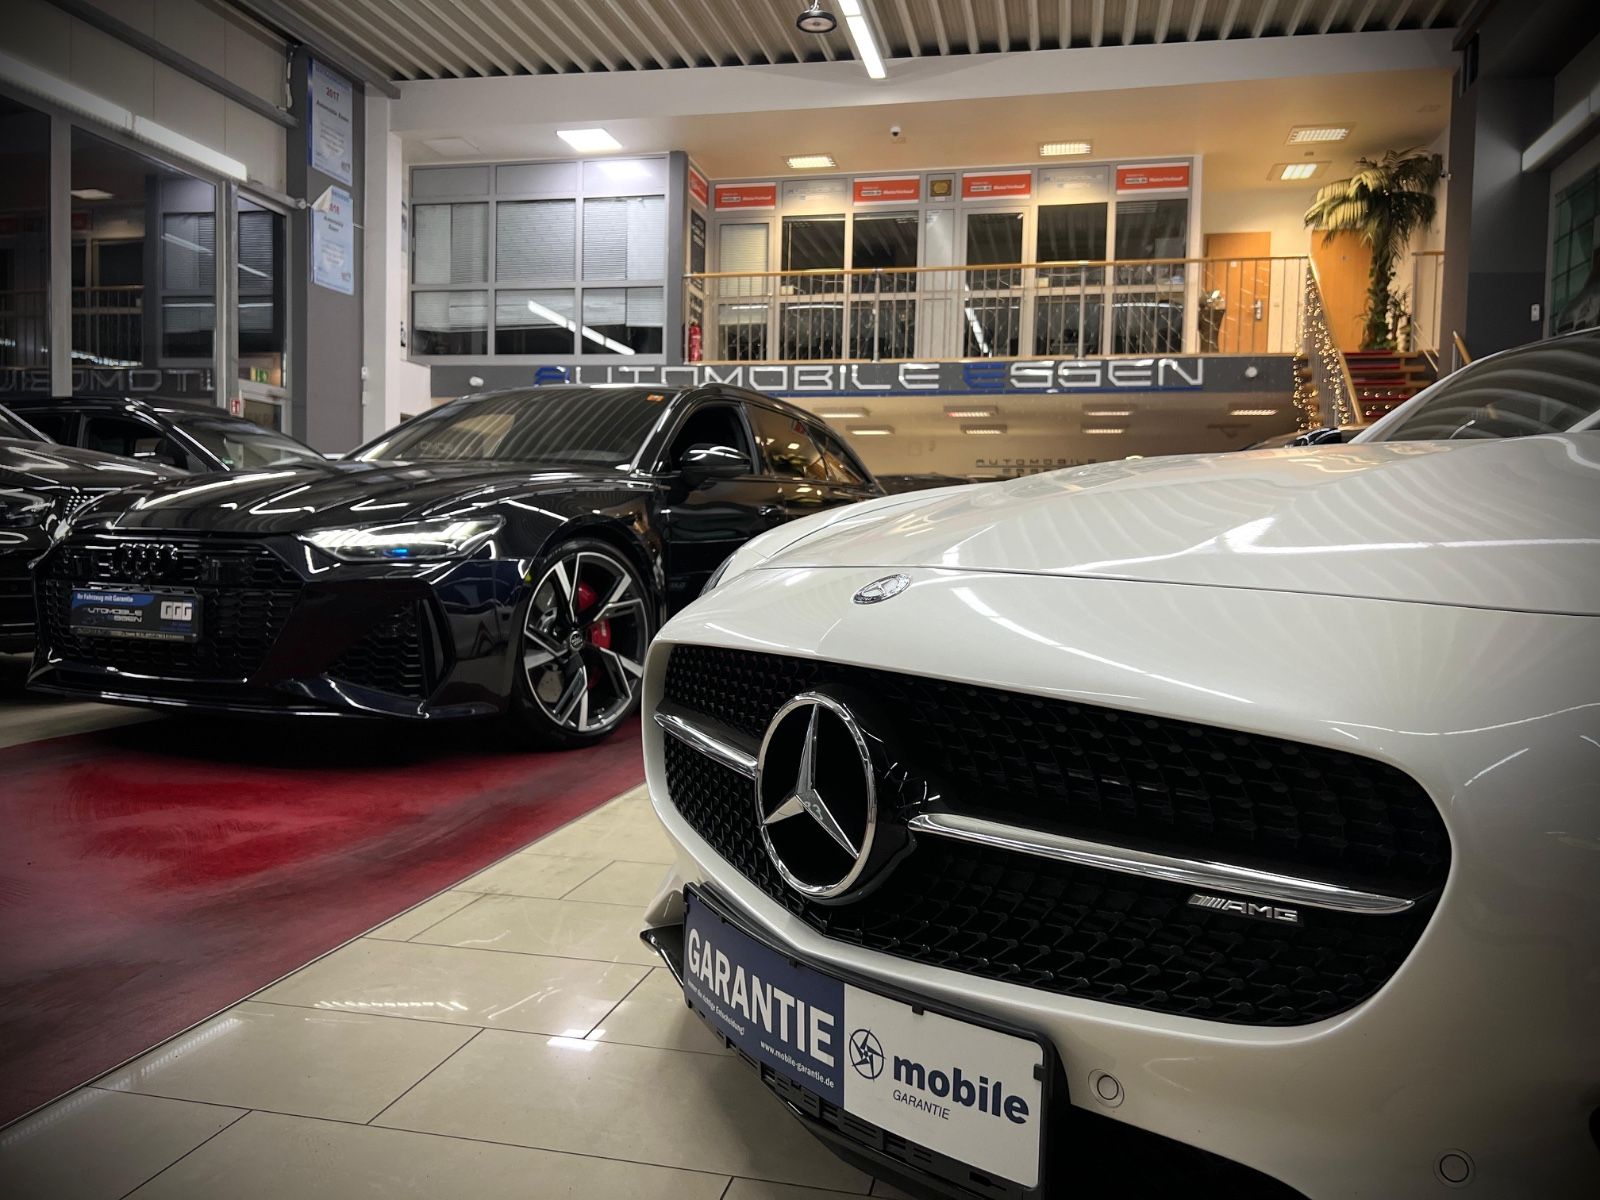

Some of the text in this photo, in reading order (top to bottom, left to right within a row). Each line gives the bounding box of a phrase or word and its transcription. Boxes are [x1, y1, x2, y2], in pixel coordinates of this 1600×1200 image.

[534, 359, 1203, 390] AUTOMOBILE ESSEN
[1222, 900, 1298, 922] AMG
[688, 928, 835, 1068] GARANTIE
[760, 1040, 835, 1089] www.mobile-garantie.de
[892, 1089, 951, 1121] GARANTIE
[893, 1055, 1030, 1125] mobile
